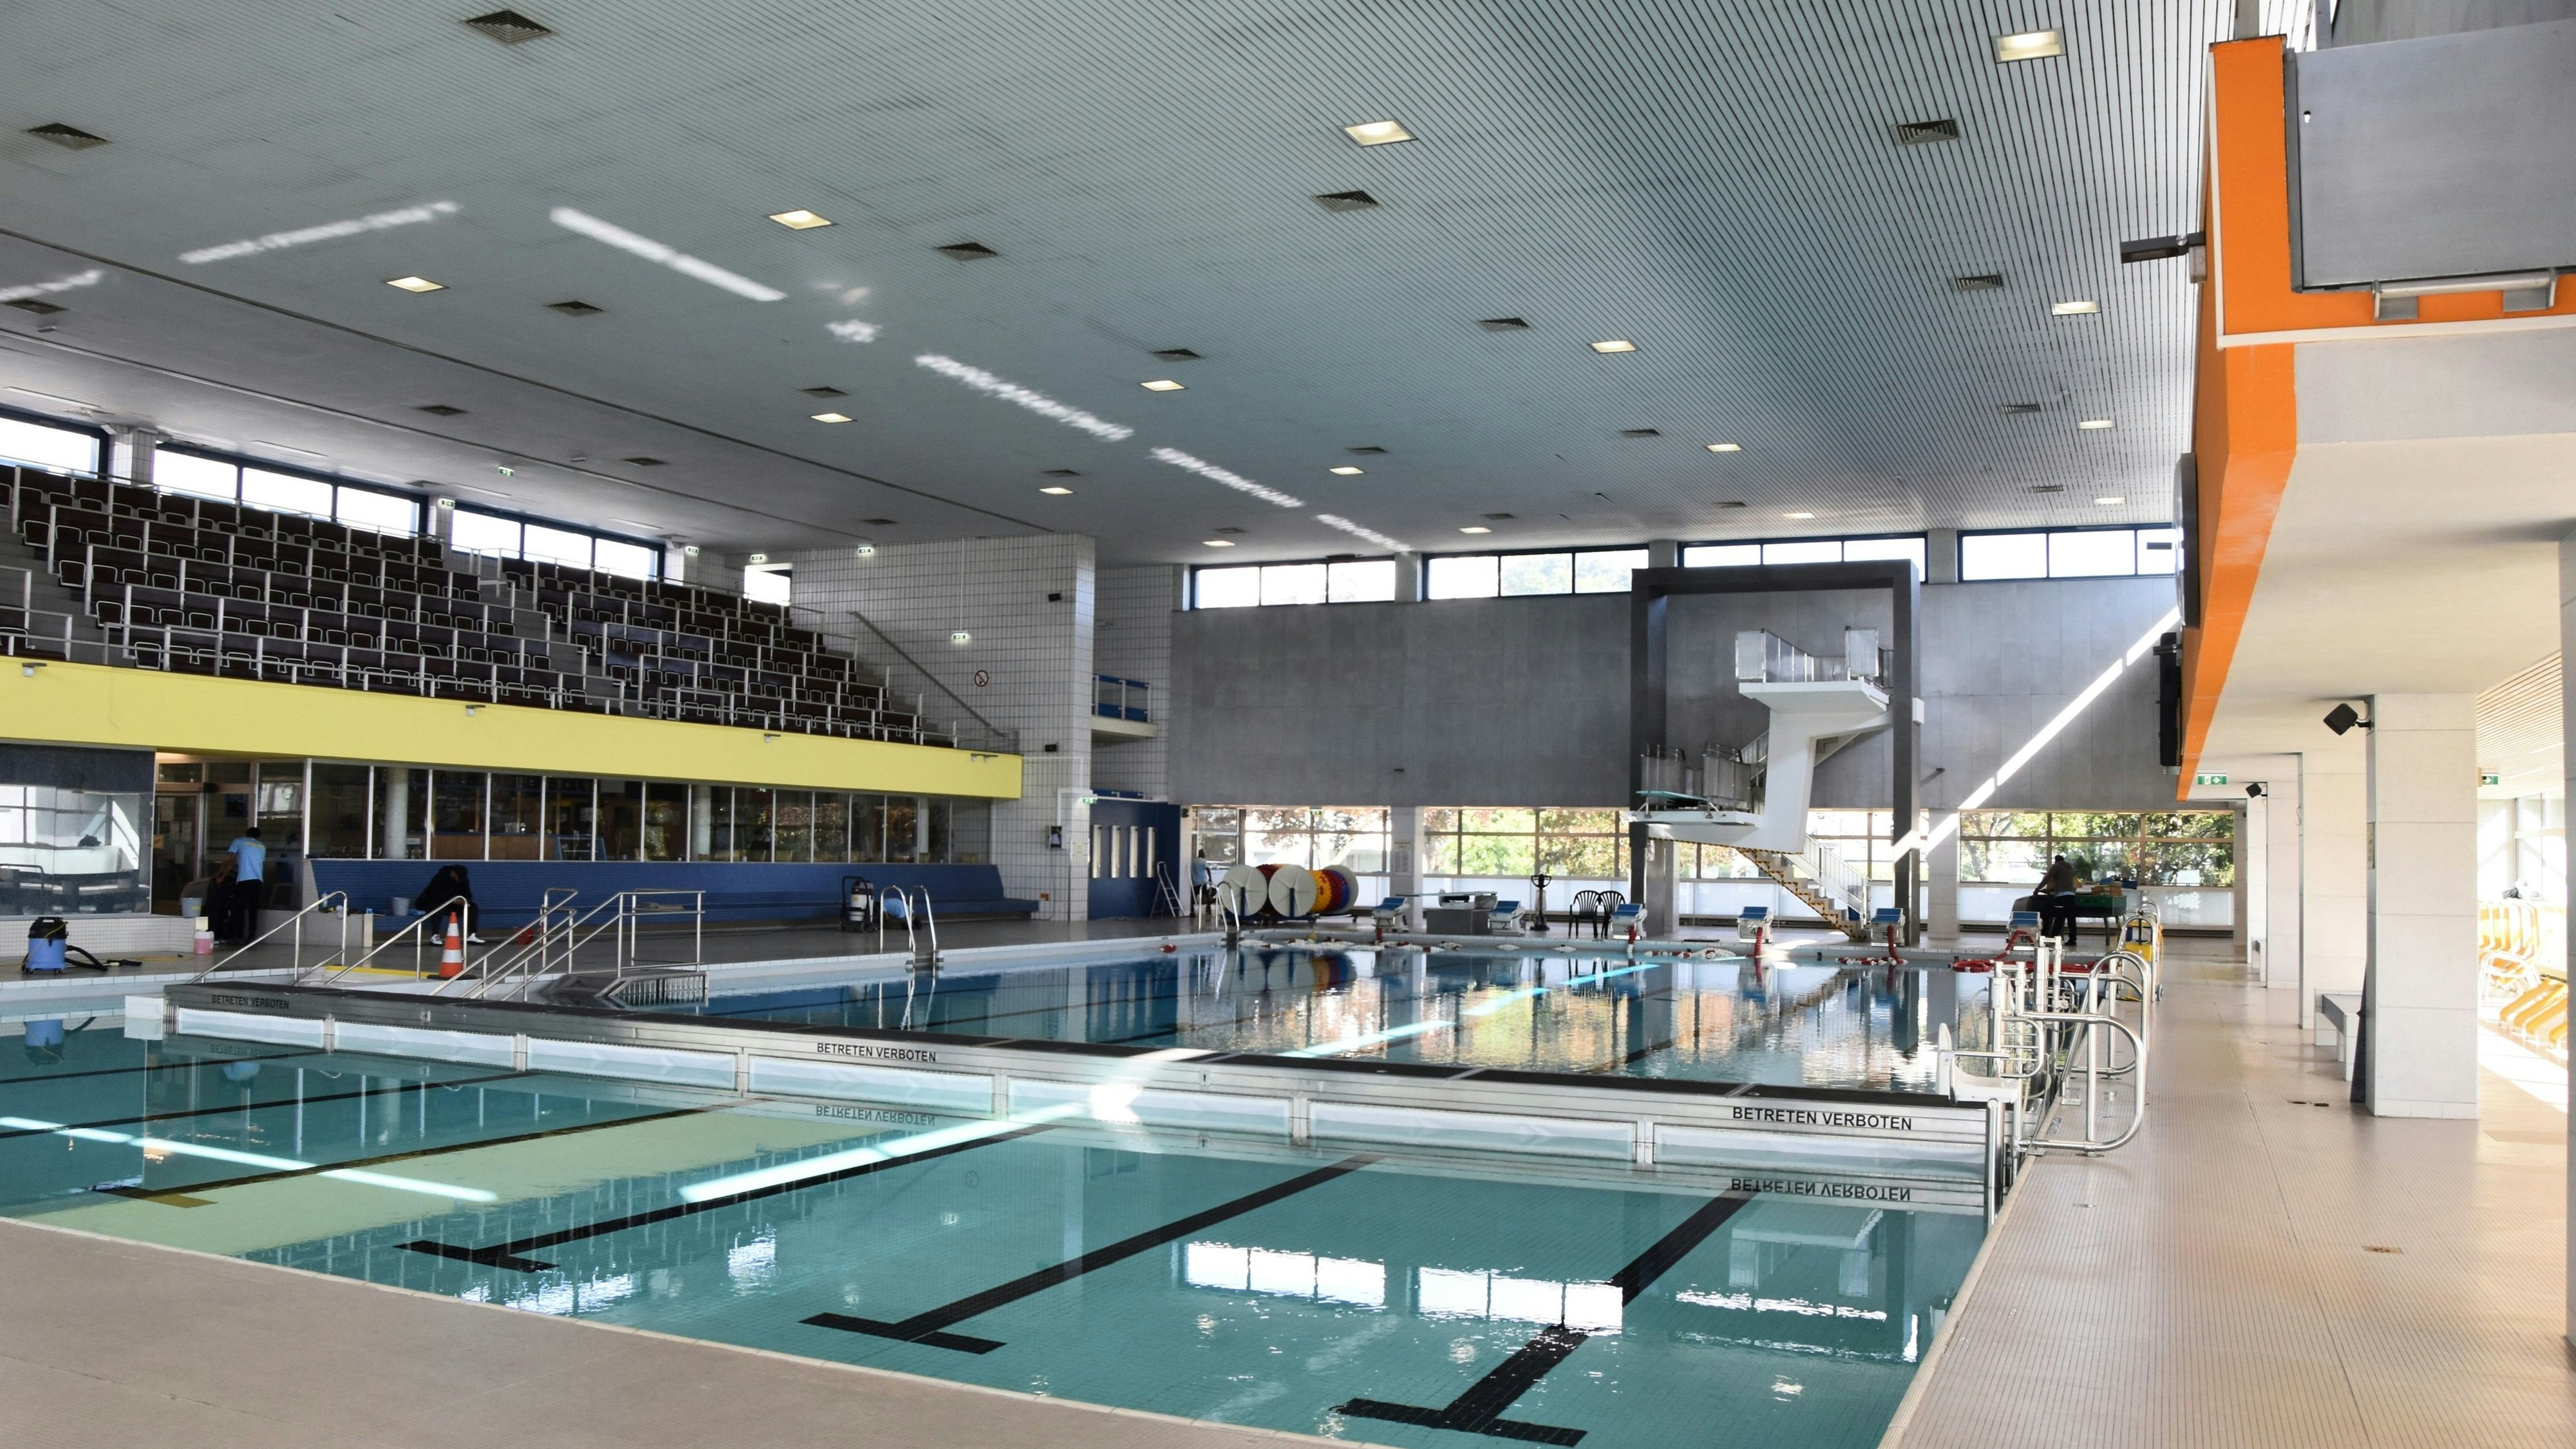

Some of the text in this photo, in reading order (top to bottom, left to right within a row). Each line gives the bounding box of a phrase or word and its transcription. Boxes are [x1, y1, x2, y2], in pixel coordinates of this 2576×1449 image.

[212, 995, 289, 1009] BETRETEN VERBOTEN
[817, 1042, 936, 1062] BETRETEN VERBOTEN
[1732, 1106, 1912, 1130] BETRETEN VERBOTEN
